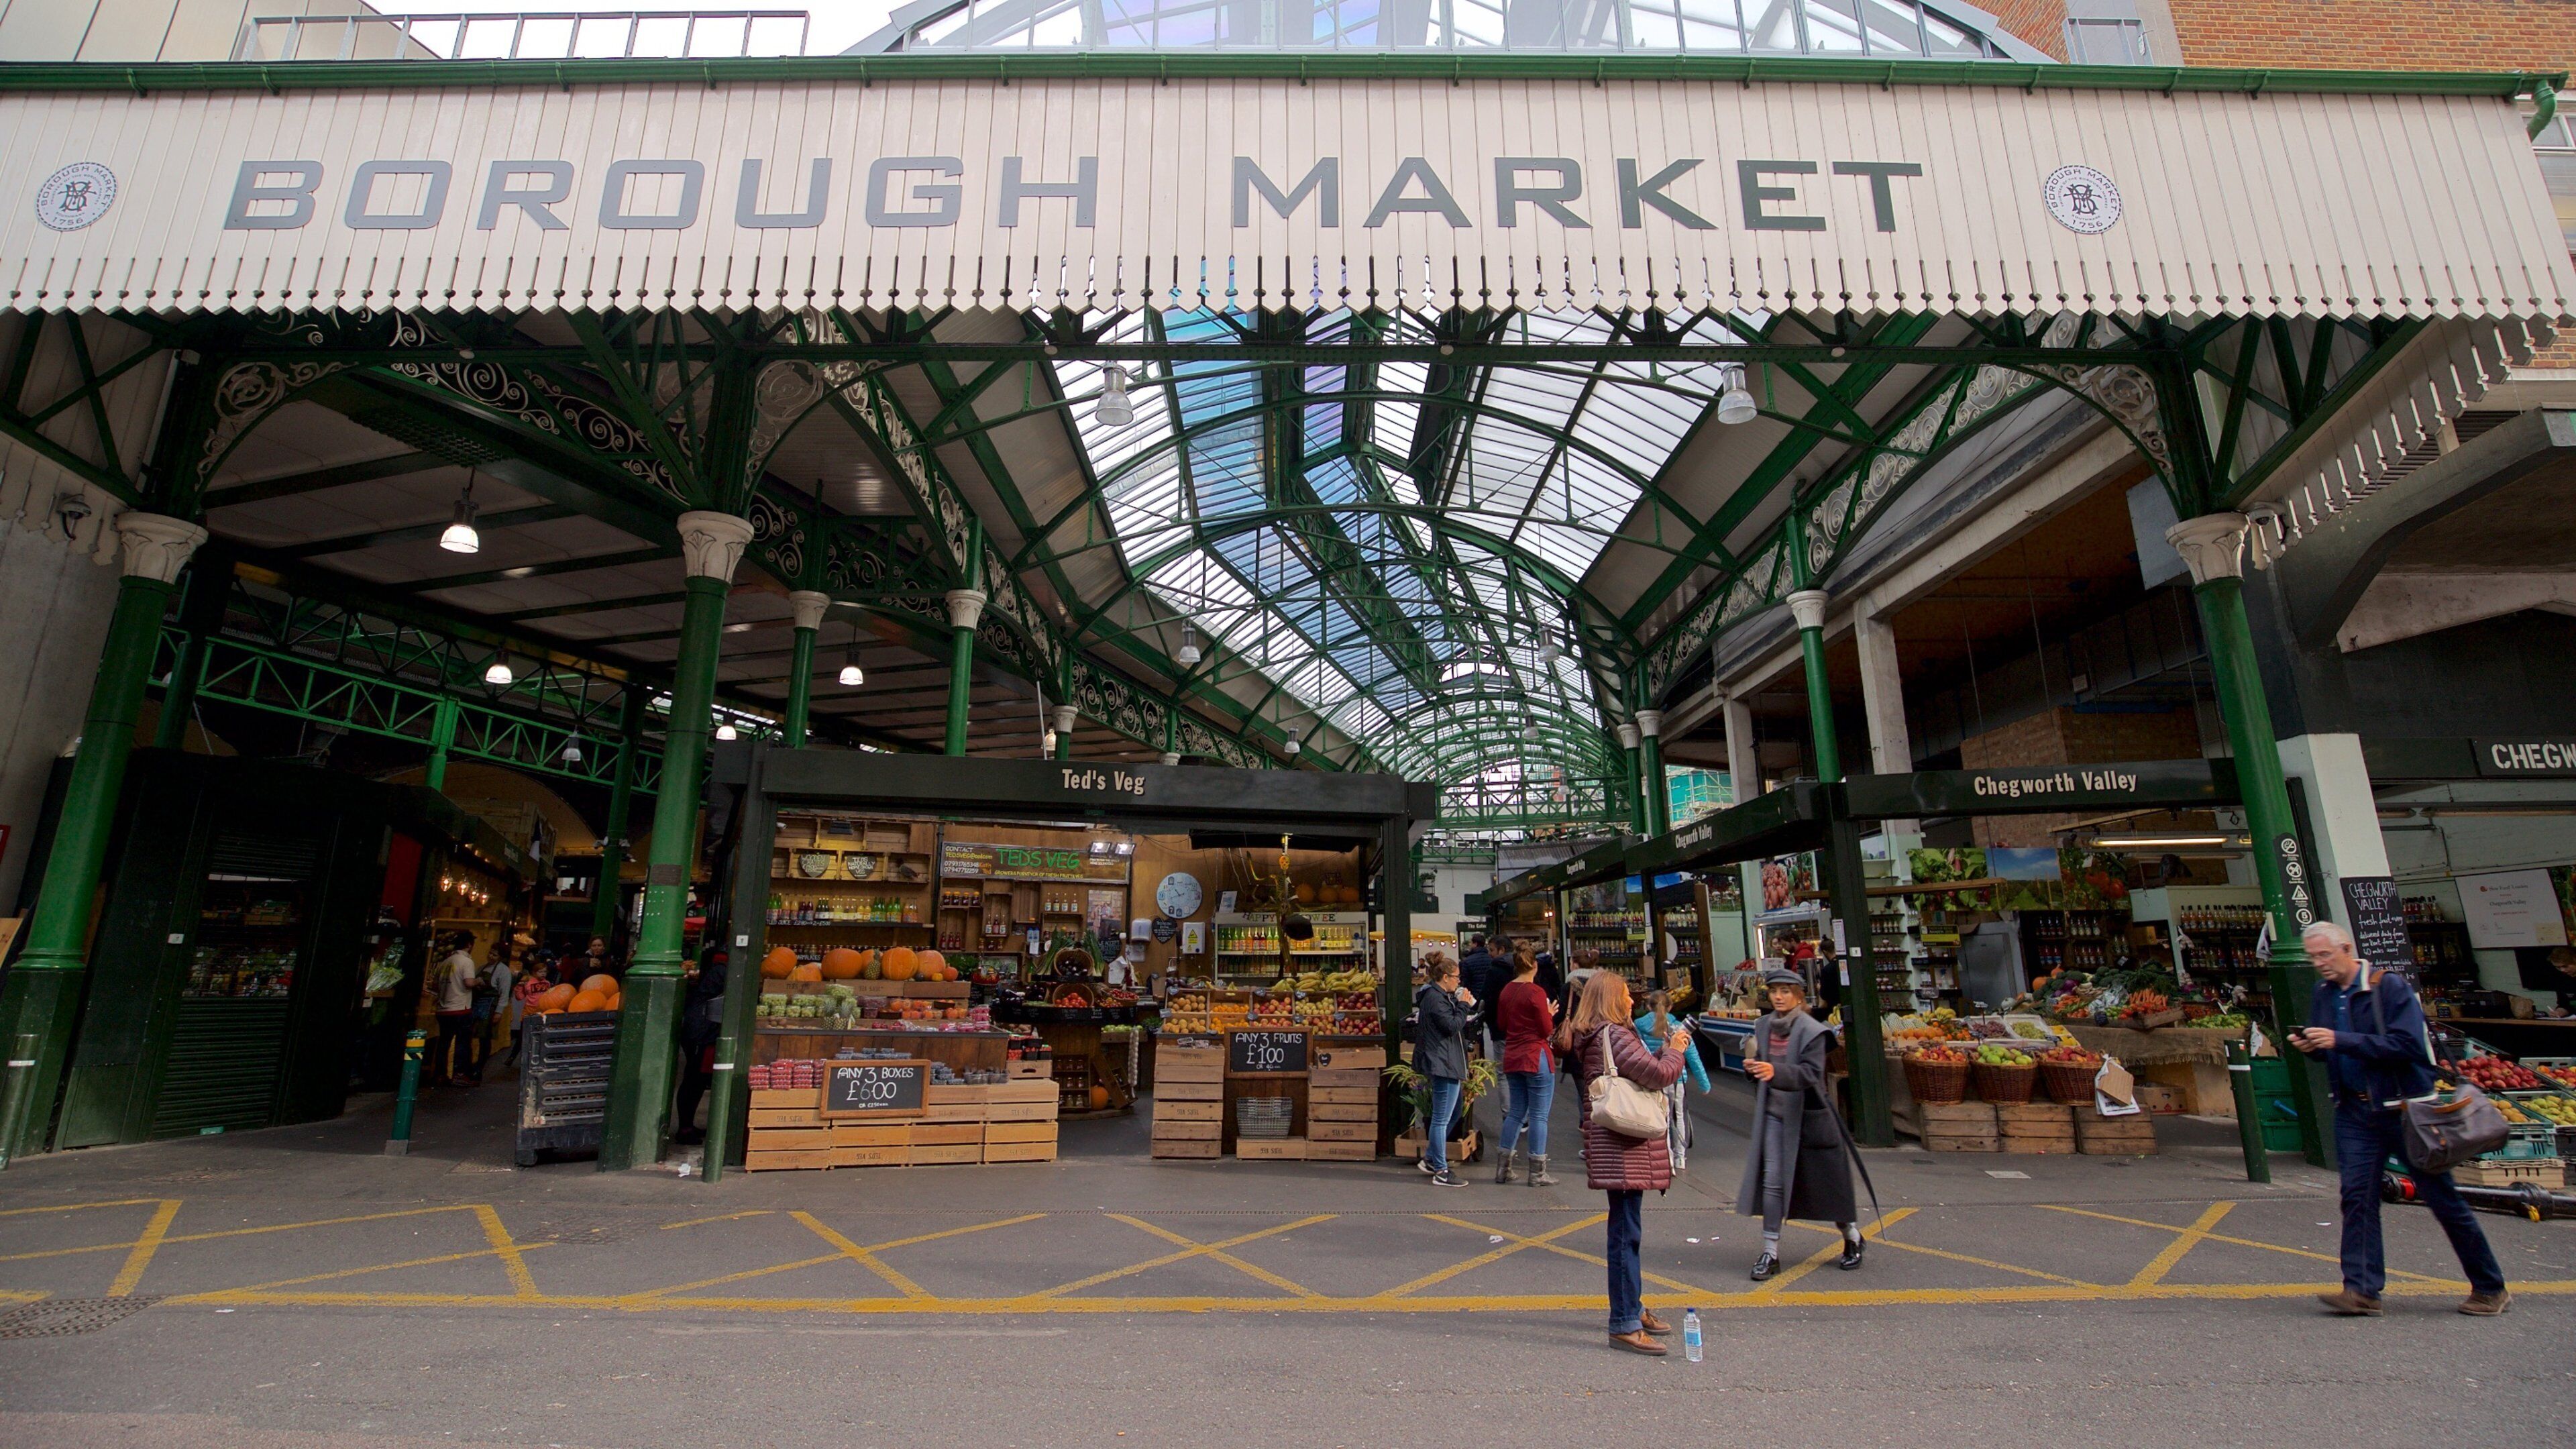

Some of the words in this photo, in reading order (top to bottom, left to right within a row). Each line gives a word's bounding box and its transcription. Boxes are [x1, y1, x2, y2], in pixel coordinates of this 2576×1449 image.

[40, 165, 90, 207] BOROUGH
[94, 167, 113, 207] MARKET
[223, 156, 1098, 230] BOROUGH
[1232, 156, 1923, 232] MARKET
[2048, 168, 2082, 209] BOROUGH
[2086, 171, 2117, 211] MARKET
[52, 216, 84, 225] 1756
[2072, 219, 2104, 229] 1756
[2491, 743, 2576, 769] CHEGW
[1062, 768, 1107, 791] Ted's
[1114, 770, 1145, 796] Veg
[1974, 772, 2076, 798] Chegworth
[2081, 769, 2137, 793] Valley
[1675, 827, 1699, 849] Chegworth
[1698, 824, 1713, 841] Valley
[1046, 851, 1081, 869] VEG
[2348, 881, 2397, 898] CHEGWORTH
[2355, 898, 2388, 911] VALLEY
[1243, 912, 1275, 922] HAPPY
[2358, 914, 2378, 929] fresh
[2359, 930, 2380, 939] delivered
[2381, 930, 2392, 939] daily
[2392, 928, 2404, 940] from
[2363, 947, 2372, 956] 40
[2386, 948, 2399, 956] away
[1235, 1033, 1259, 1043] ANY
[1259, 1033, 1270, 1049] 3
[1273, 1033, 1303, 1044] FRUITS
[837, 1067, 863, 1079] ANY
[864, 1067, 877, 1083] 3
[881, 1067, 914, 1079] BOXES
